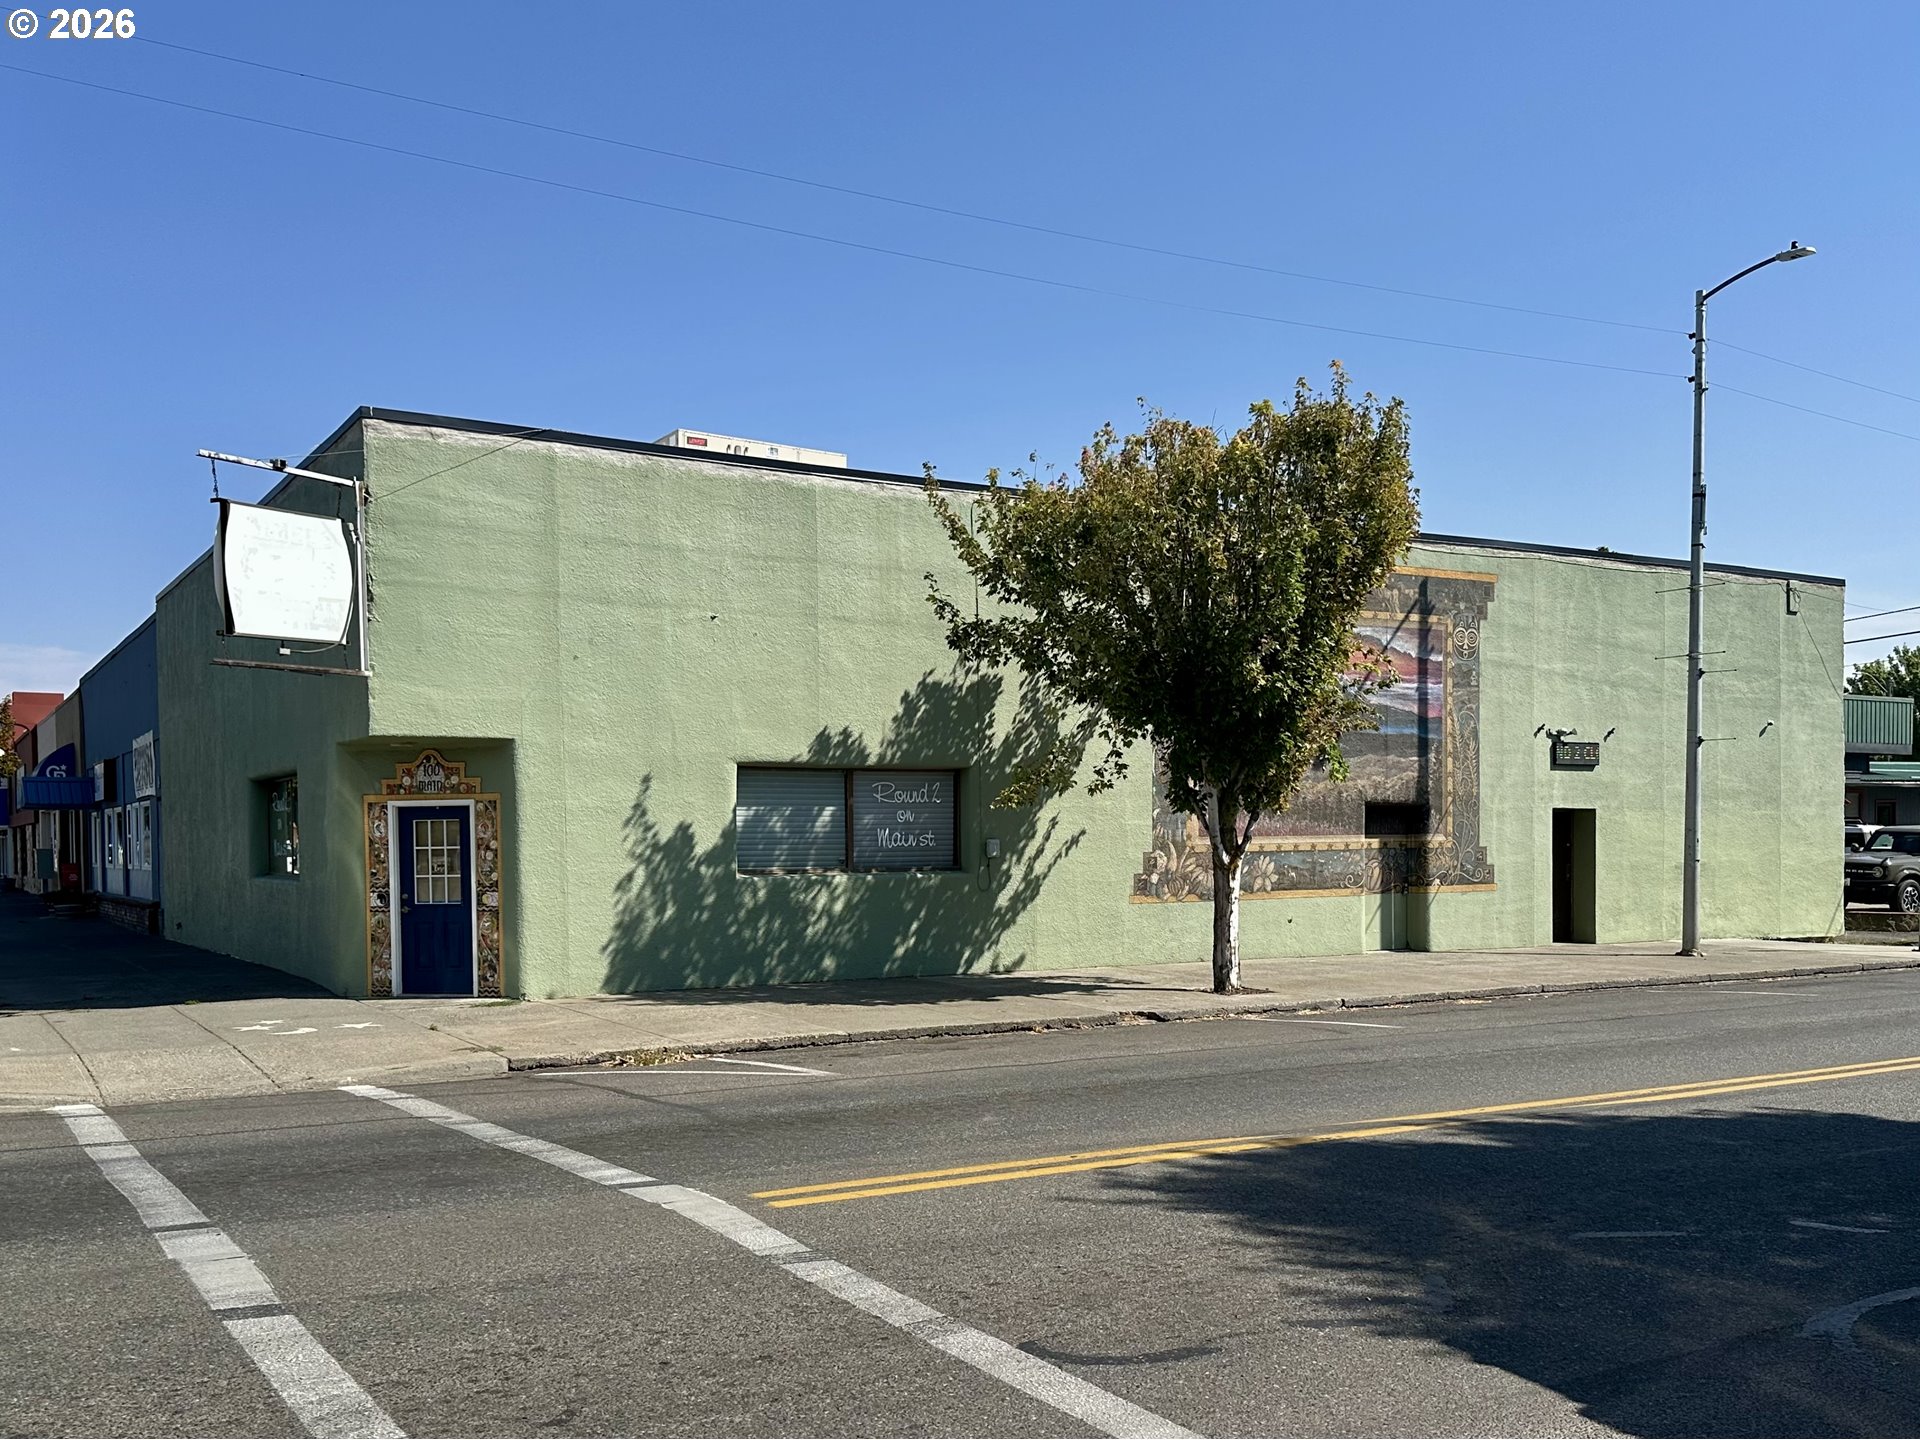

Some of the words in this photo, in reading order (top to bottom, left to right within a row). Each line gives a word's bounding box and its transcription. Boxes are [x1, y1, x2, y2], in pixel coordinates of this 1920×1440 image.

[423, 764, 440, 777] 100
[872, 782, 929, 803] Round
[932, 782, 941, 803] 2
[896, 809, 915, 823] on
[877, 827, 917, 849] Main
